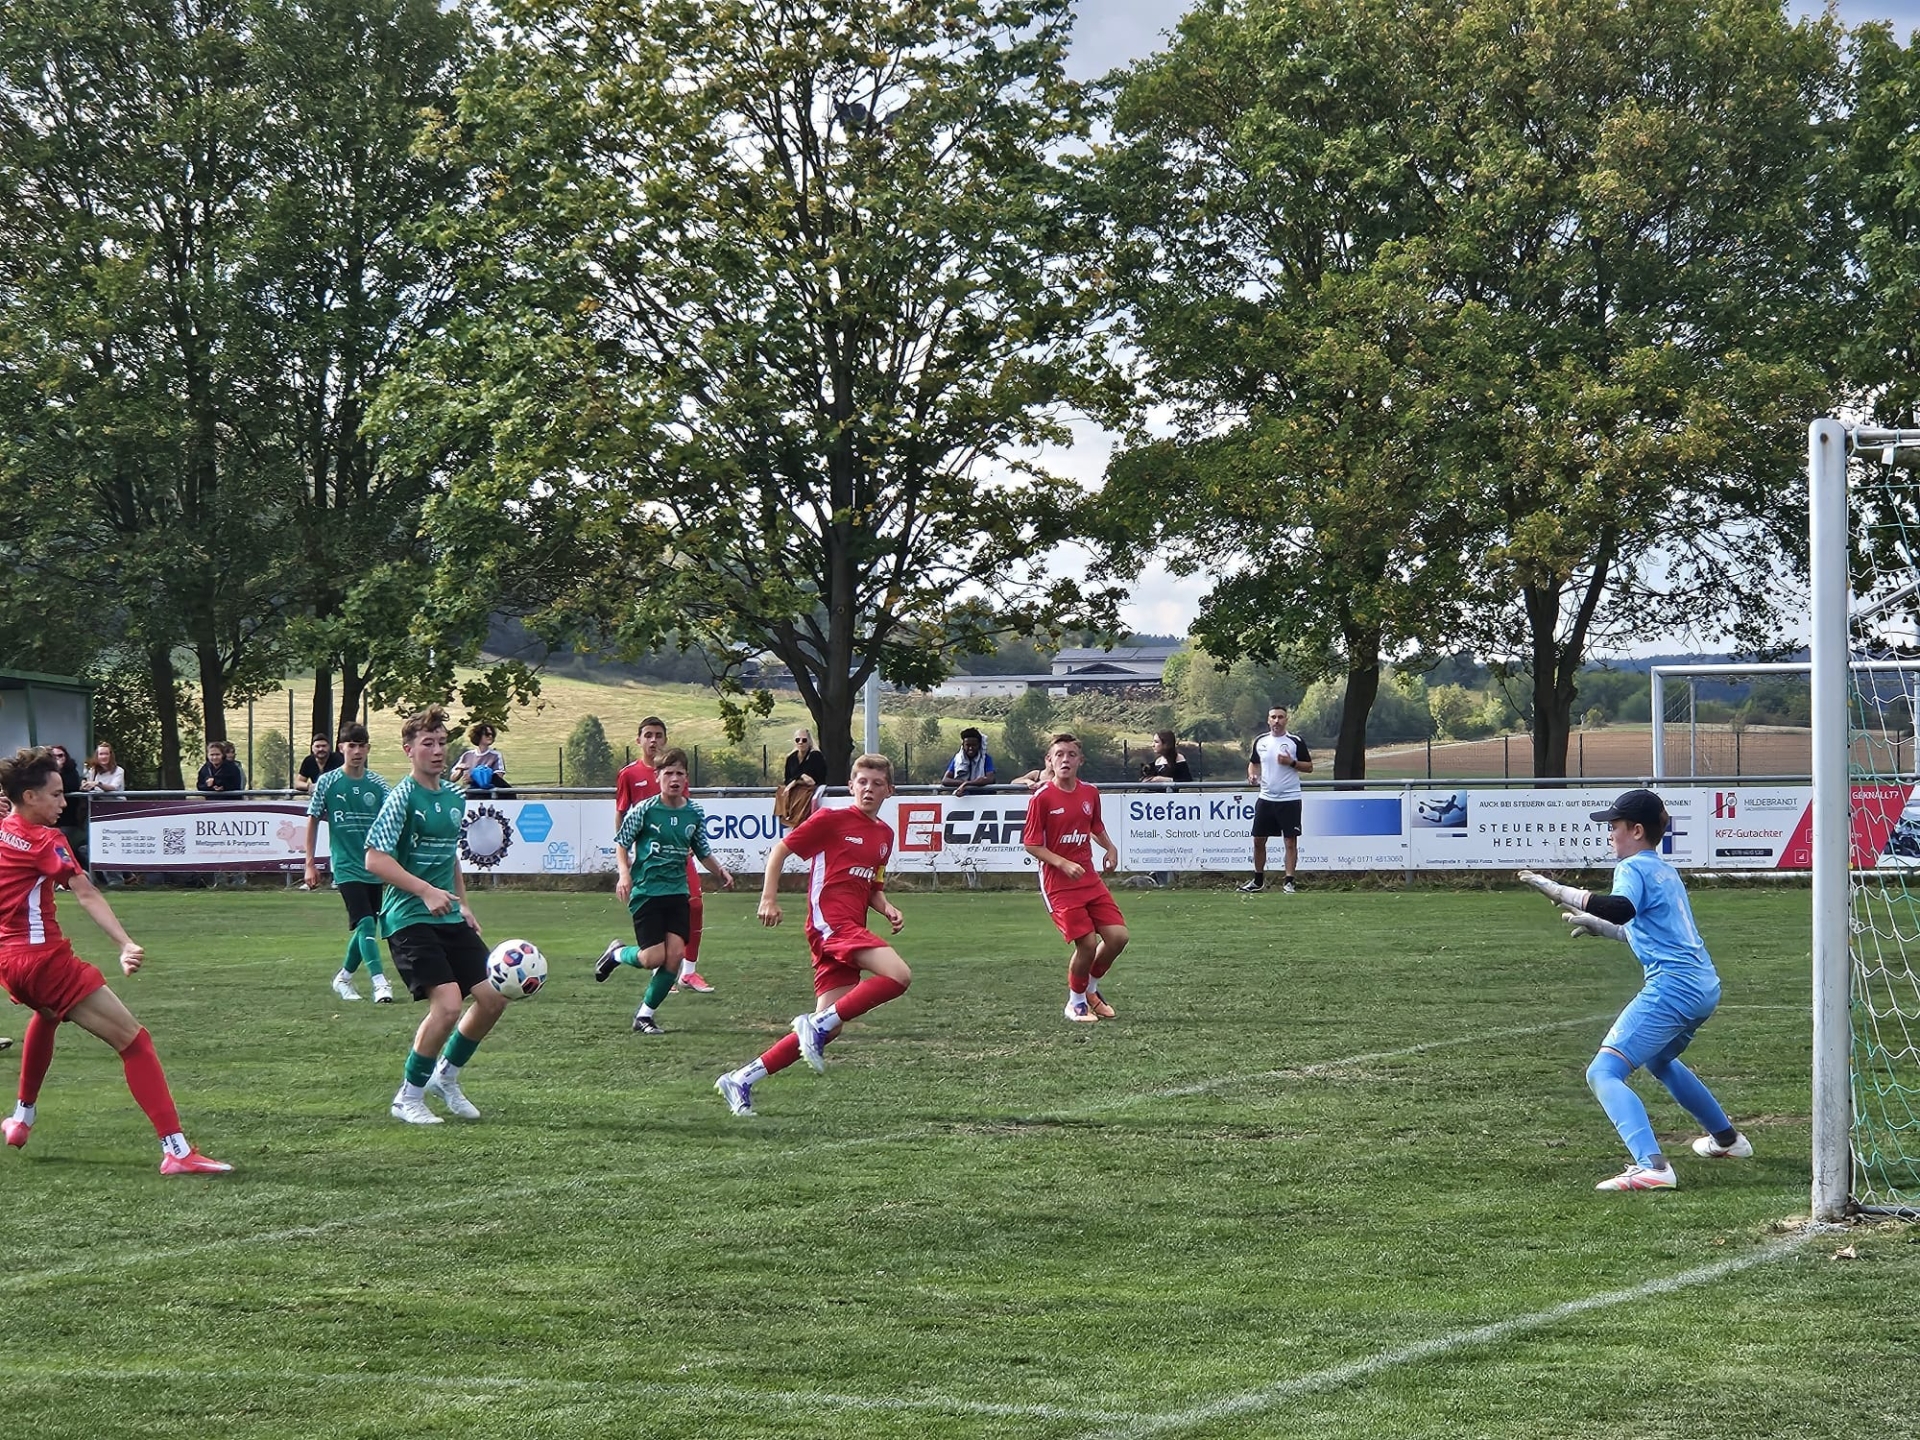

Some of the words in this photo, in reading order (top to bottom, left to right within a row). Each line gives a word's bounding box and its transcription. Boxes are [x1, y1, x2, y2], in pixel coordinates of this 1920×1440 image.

[1744, 798, 1798, 806] HILDEBRANDT
[435, 802, 442, 813] 6
[1129, 801, 1201, 821] Stefan
[1209, 799, 1255, 820] Krie
[196, 820, 270, 836] BRANDT
[1165, 828, 1200, 838] Schrott-
[1203, 829, 1220, 838] und
[1715, 829, 1784, 838] KFZ-Gutachter
[1493, 838, 1533, 847] HEIL
